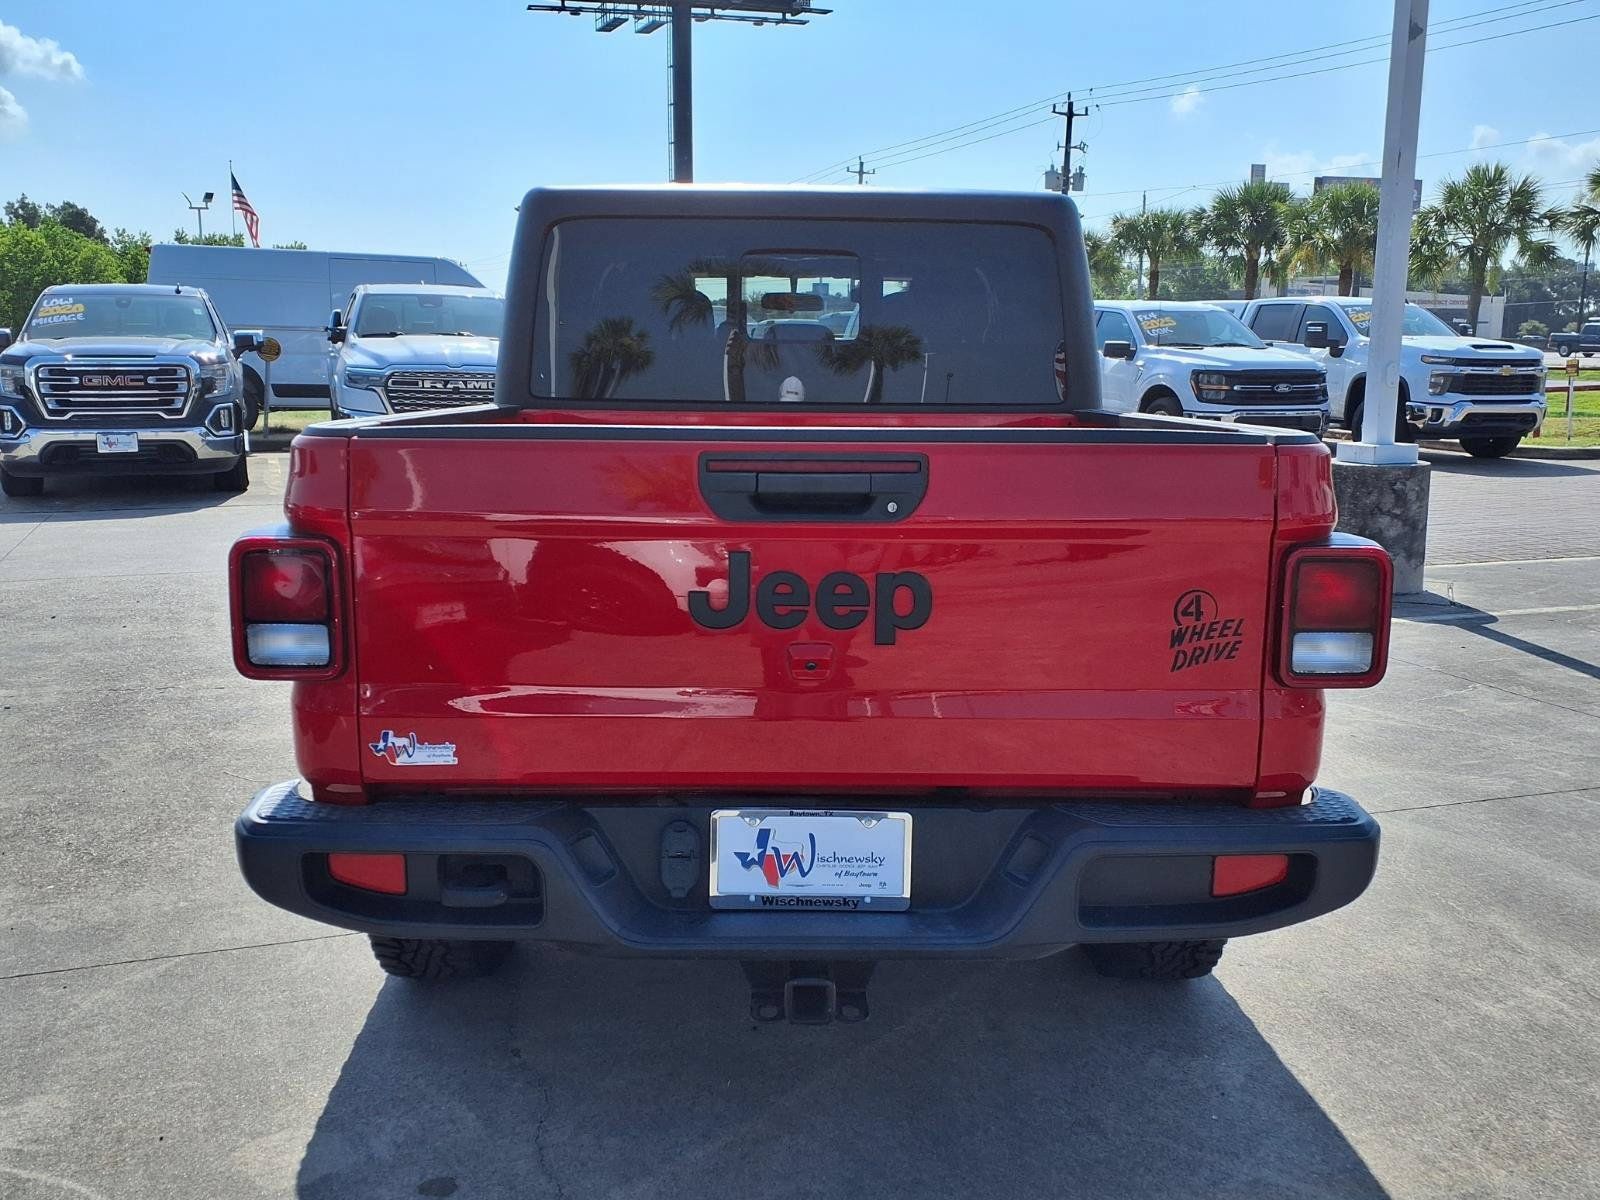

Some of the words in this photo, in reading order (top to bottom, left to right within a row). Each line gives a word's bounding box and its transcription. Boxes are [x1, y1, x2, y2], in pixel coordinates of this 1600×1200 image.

[43, 297, 73, 306] LOW
[31, 313, 85, 327] MILEAGE
[83, 374, 145, 386] GMC
[688, 551, 932, 645] Jeep
[1181, 595, 1204, 621] 4
[1169, 618, 1244, 649] WHEEL
[1170, 641, 1243, 673] DRIVE
[835, 870, 843, 878] of
[844, 870, 878, 878] Baytown
[761, 895, 860, 909] Wischnewsky
